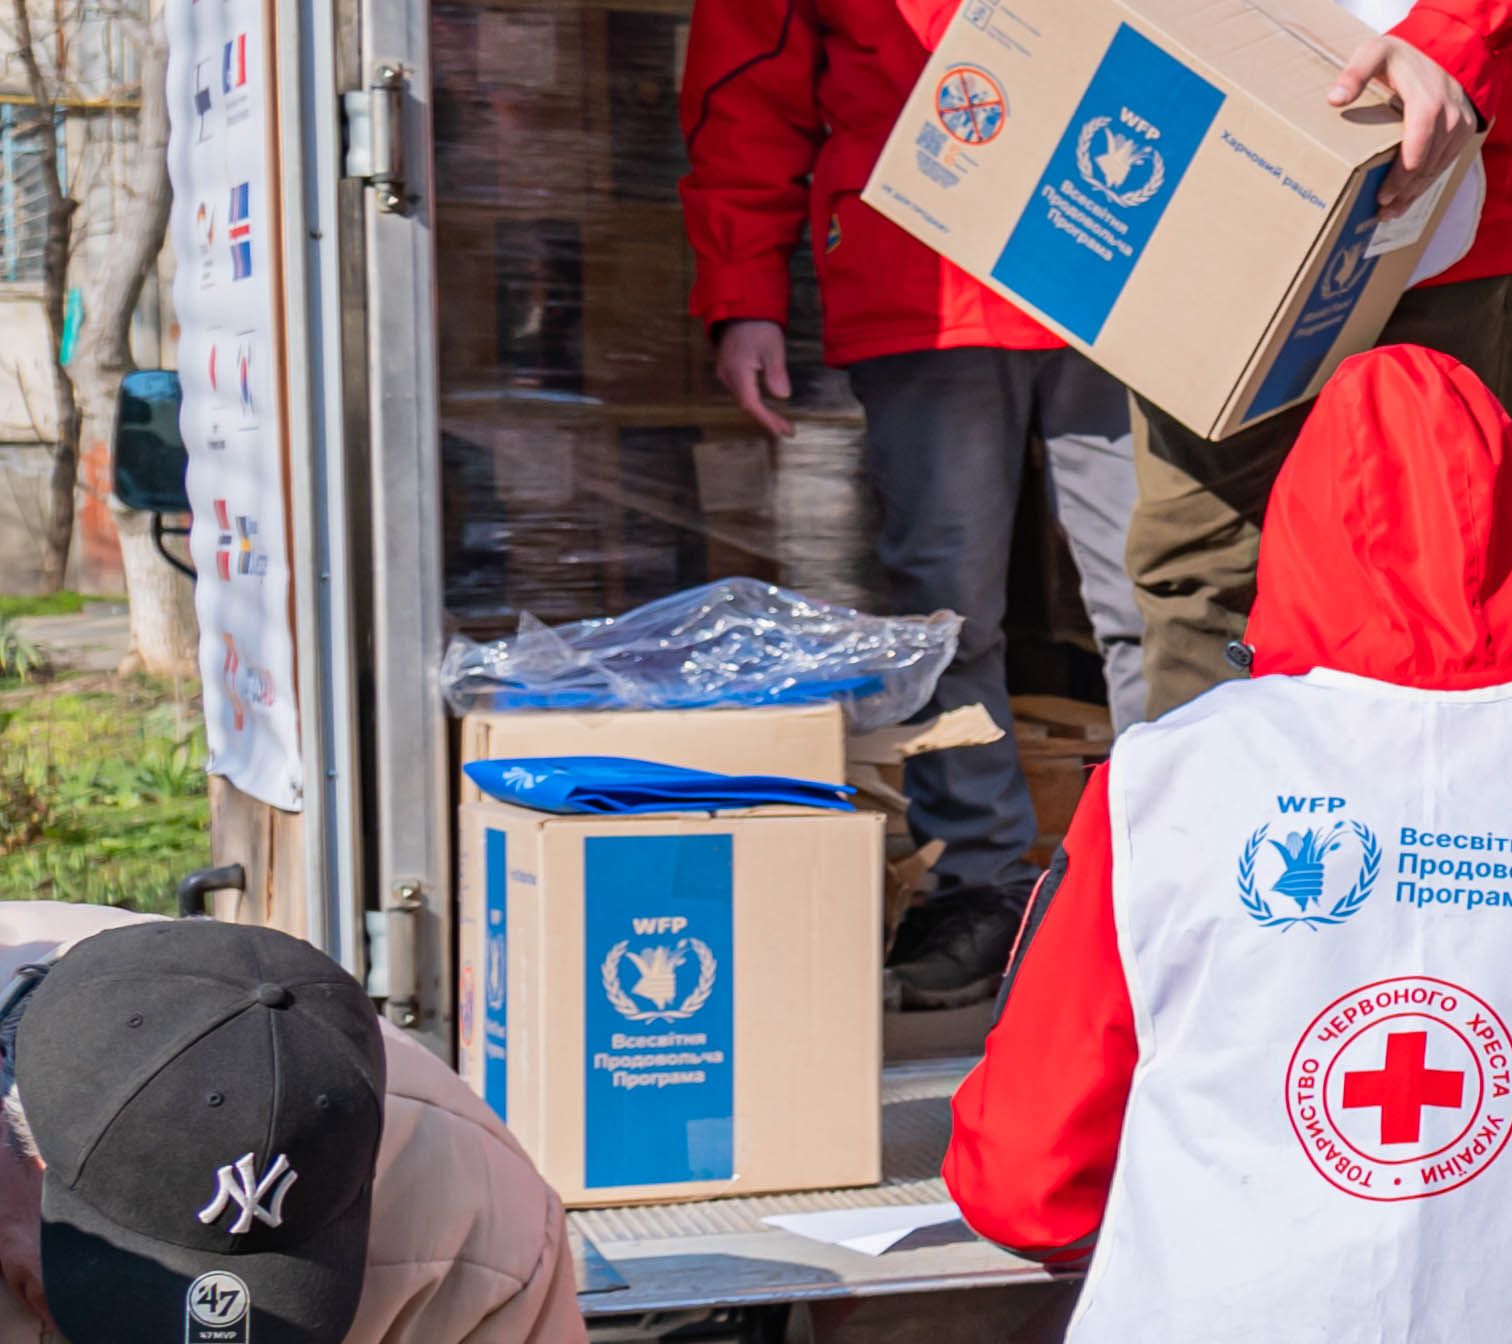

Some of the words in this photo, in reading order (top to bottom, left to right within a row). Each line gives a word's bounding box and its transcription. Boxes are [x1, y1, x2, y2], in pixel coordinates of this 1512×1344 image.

[1120, 106, 1160, 141] WFP
[1221, 129, 1282, 179] Харчовий
[1283, 172, 1327, 210] раціон
[1041, 185, 1134, 257] Продовольча
[1047, 207, 1114, 262] Програма
[1060, 179, 1129, 235] Всесвітня
[1277, 795, 1346, 814] WFP
[633, 916, 688, 935] WFP
[611, 1032, 707, 1050] Всесвітня
[1317, 987, 1458, 1043] ЧЕРВОНОГО
[594, 1051, 724, 1071] Продовольча
[612, 1070, 705, 1088] Програма
[1465, 1013, 1511, 1098] ХРЕСТА
[1298, 1058, 1373, 1188] ТОВАРИСТВО
[1421, 1115, 1505, 1185] УКРАЇНИ
